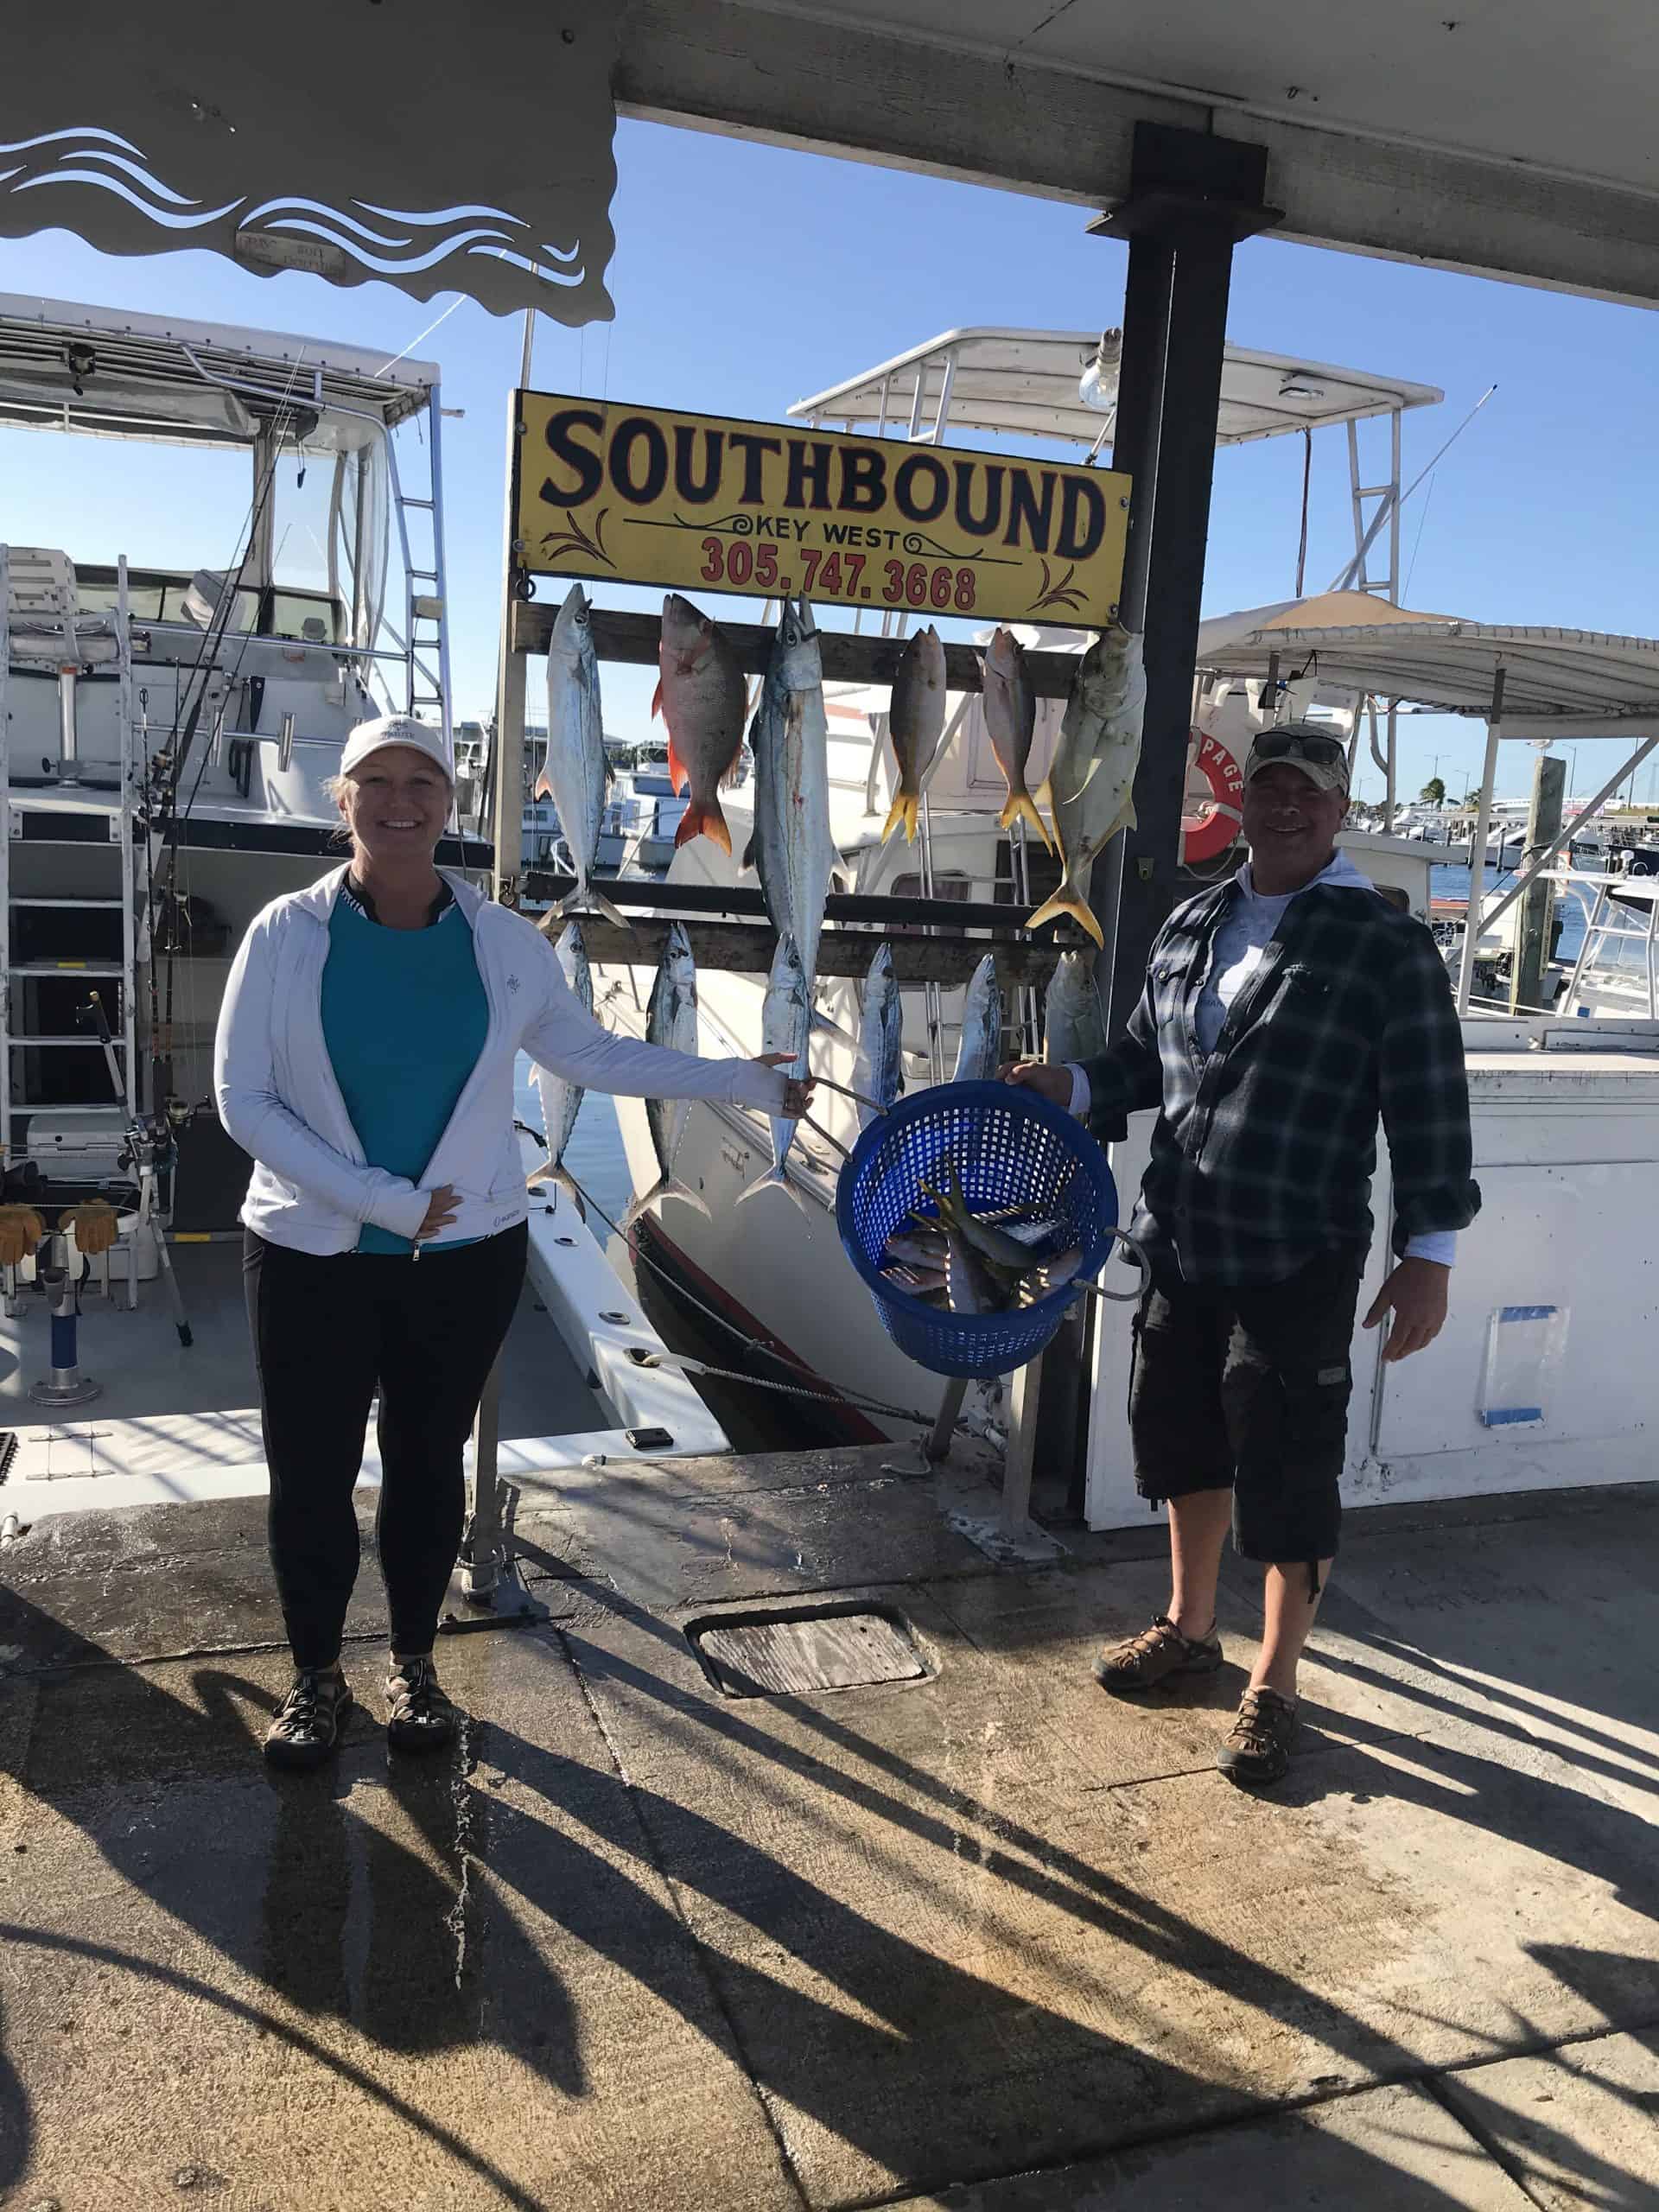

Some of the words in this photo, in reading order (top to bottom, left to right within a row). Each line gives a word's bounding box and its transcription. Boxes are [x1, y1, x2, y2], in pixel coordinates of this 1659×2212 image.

[539, 410, 1106, 561] SOUTHBOUND
[754, 516, 810, 542] KEY
[823, 522, 901, 551] WEST
[1202, 740, 1243, 791] PAGE
